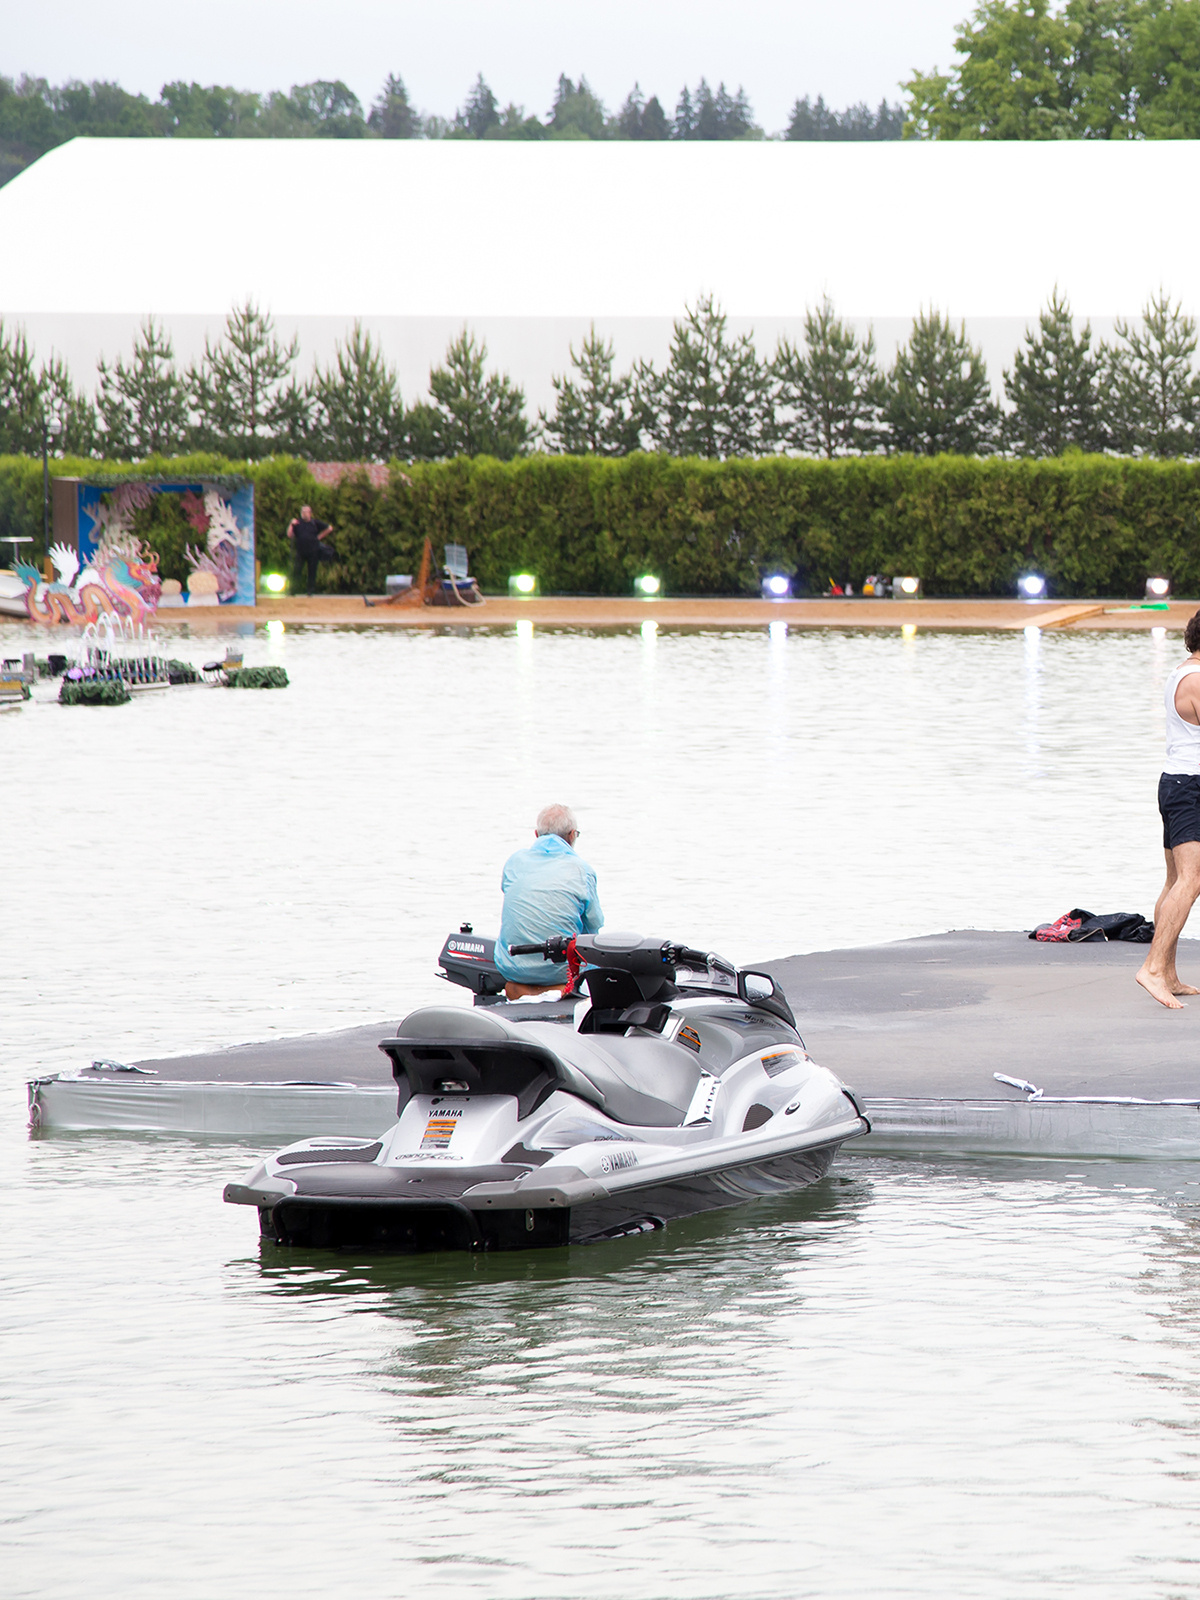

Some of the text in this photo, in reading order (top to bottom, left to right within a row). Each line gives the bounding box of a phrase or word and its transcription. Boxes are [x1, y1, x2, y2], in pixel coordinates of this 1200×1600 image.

[456, 941, 485, 954] YAMAHA
[428, 1109, 464, 1118] YAMAHA
[606, 1150, 640, 1171] YAMAHA
